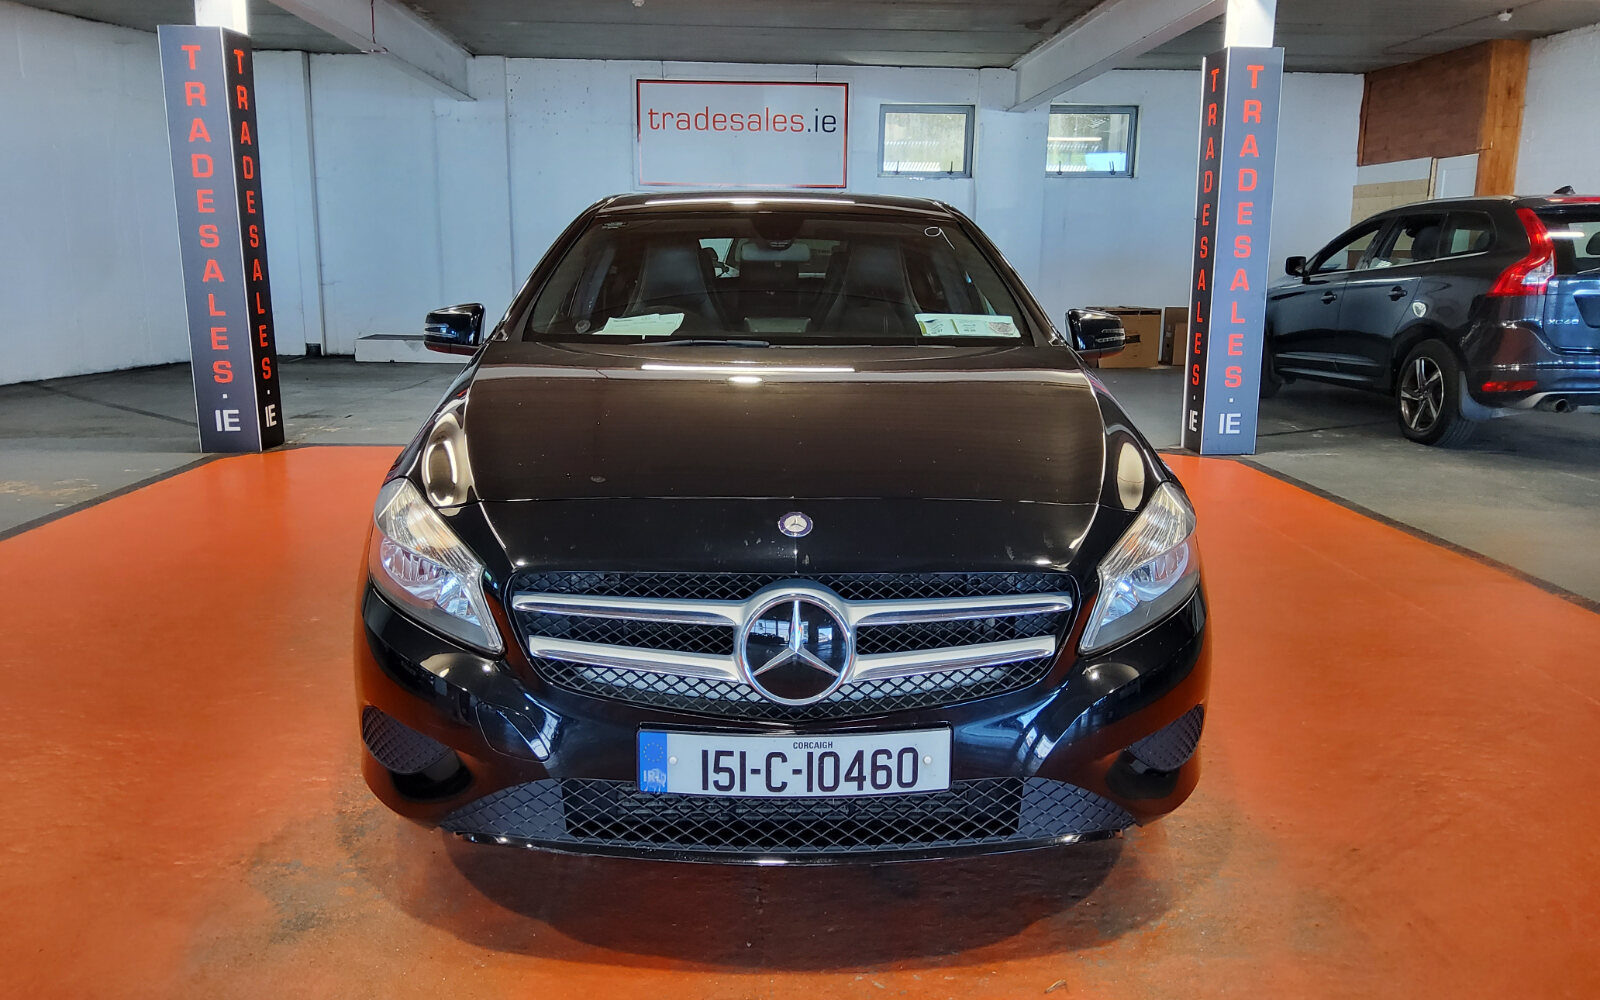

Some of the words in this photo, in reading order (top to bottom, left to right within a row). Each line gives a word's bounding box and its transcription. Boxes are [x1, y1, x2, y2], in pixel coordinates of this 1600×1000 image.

[648, 106, 837, 133] tradesales.ie
[793, 741, 833, 750] CORCAIGH
[701, 747, 919, 793] 151-C-10460
